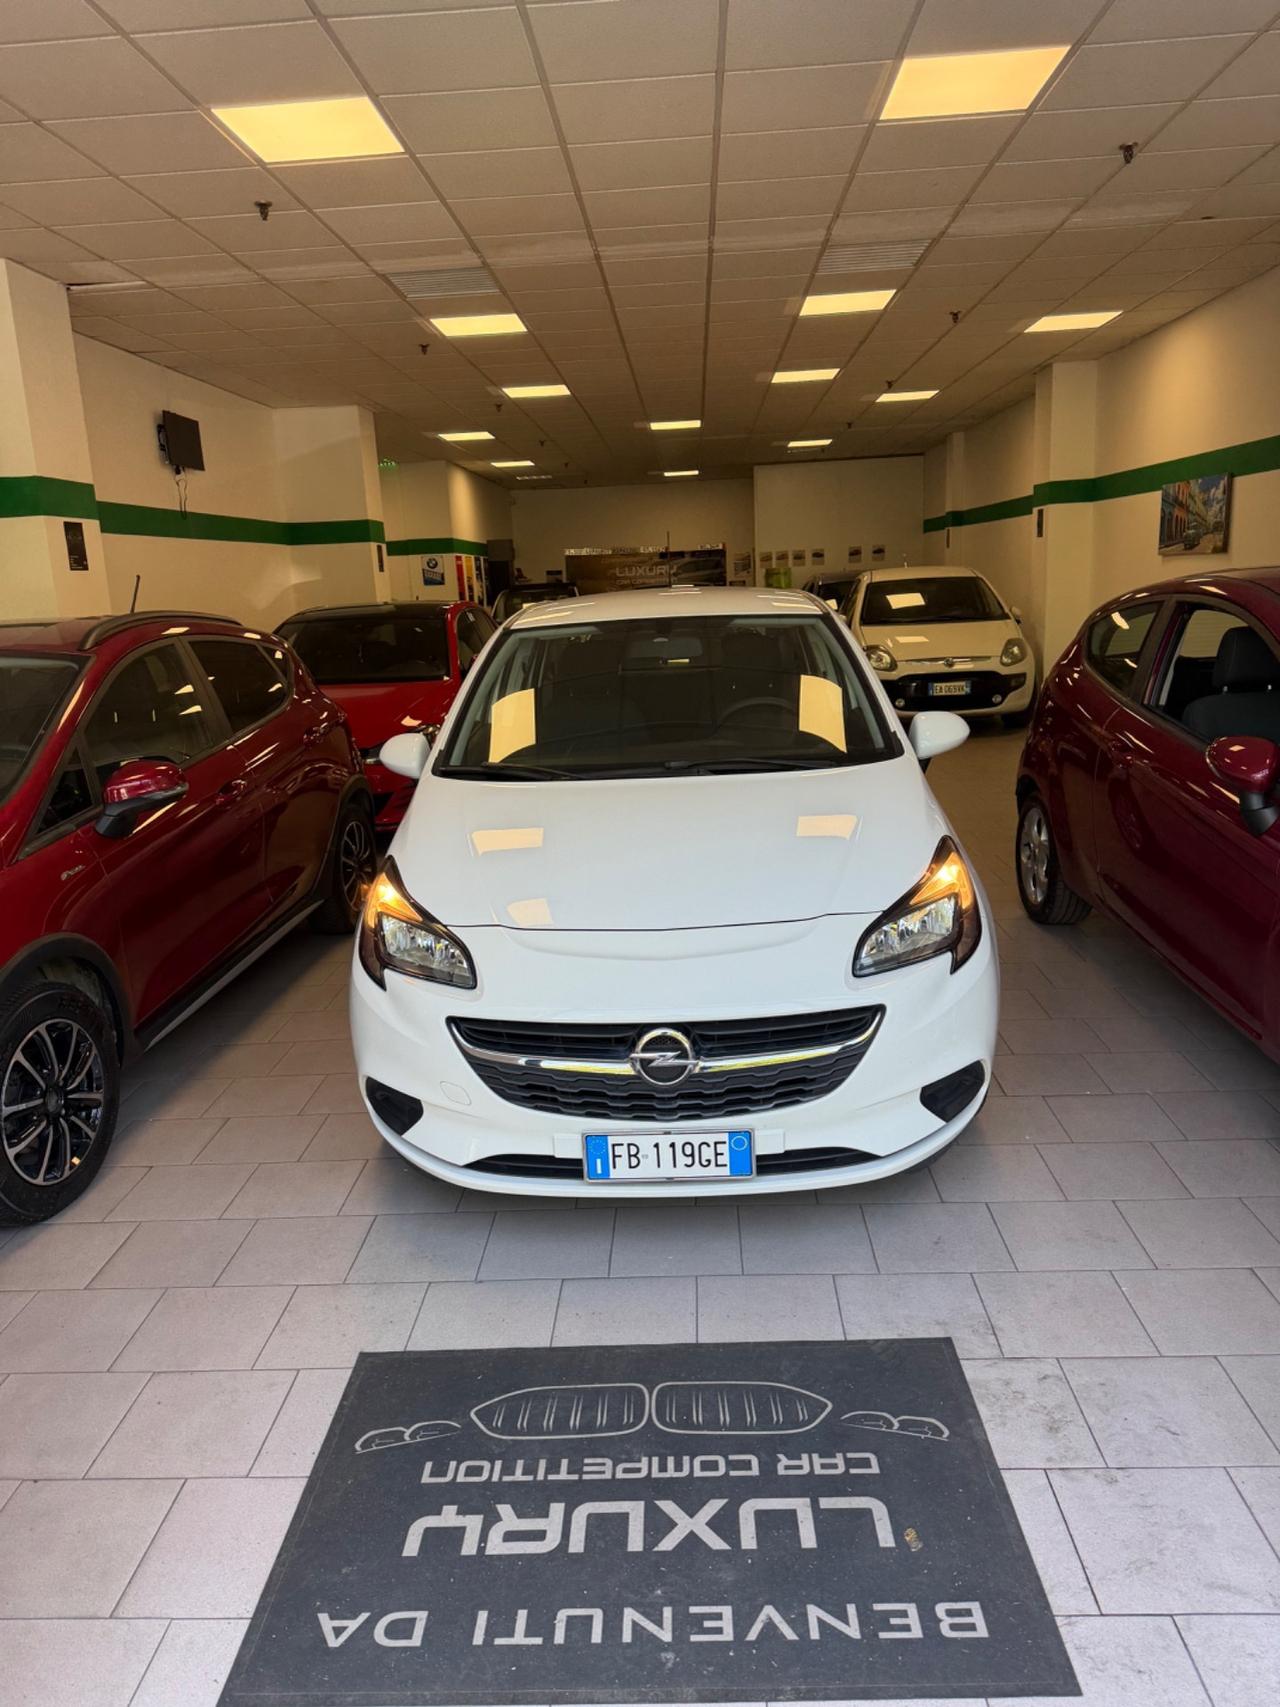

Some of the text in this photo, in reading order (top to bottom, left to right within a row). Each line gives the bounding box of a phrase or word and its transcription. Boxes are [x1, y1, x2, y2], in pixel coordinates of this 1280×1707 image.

[615, 565, 678, 577] LUXURY
[611, 1142, 641, 1169] FB
[653, 1141, 728, 1168] 119GE
[420, 1452, 881, 1484] CAR COMPETITION
[401, 1496, 896, 1557] LUXURY
[317, 1601, 990, 1648] BENVENUTI DA
